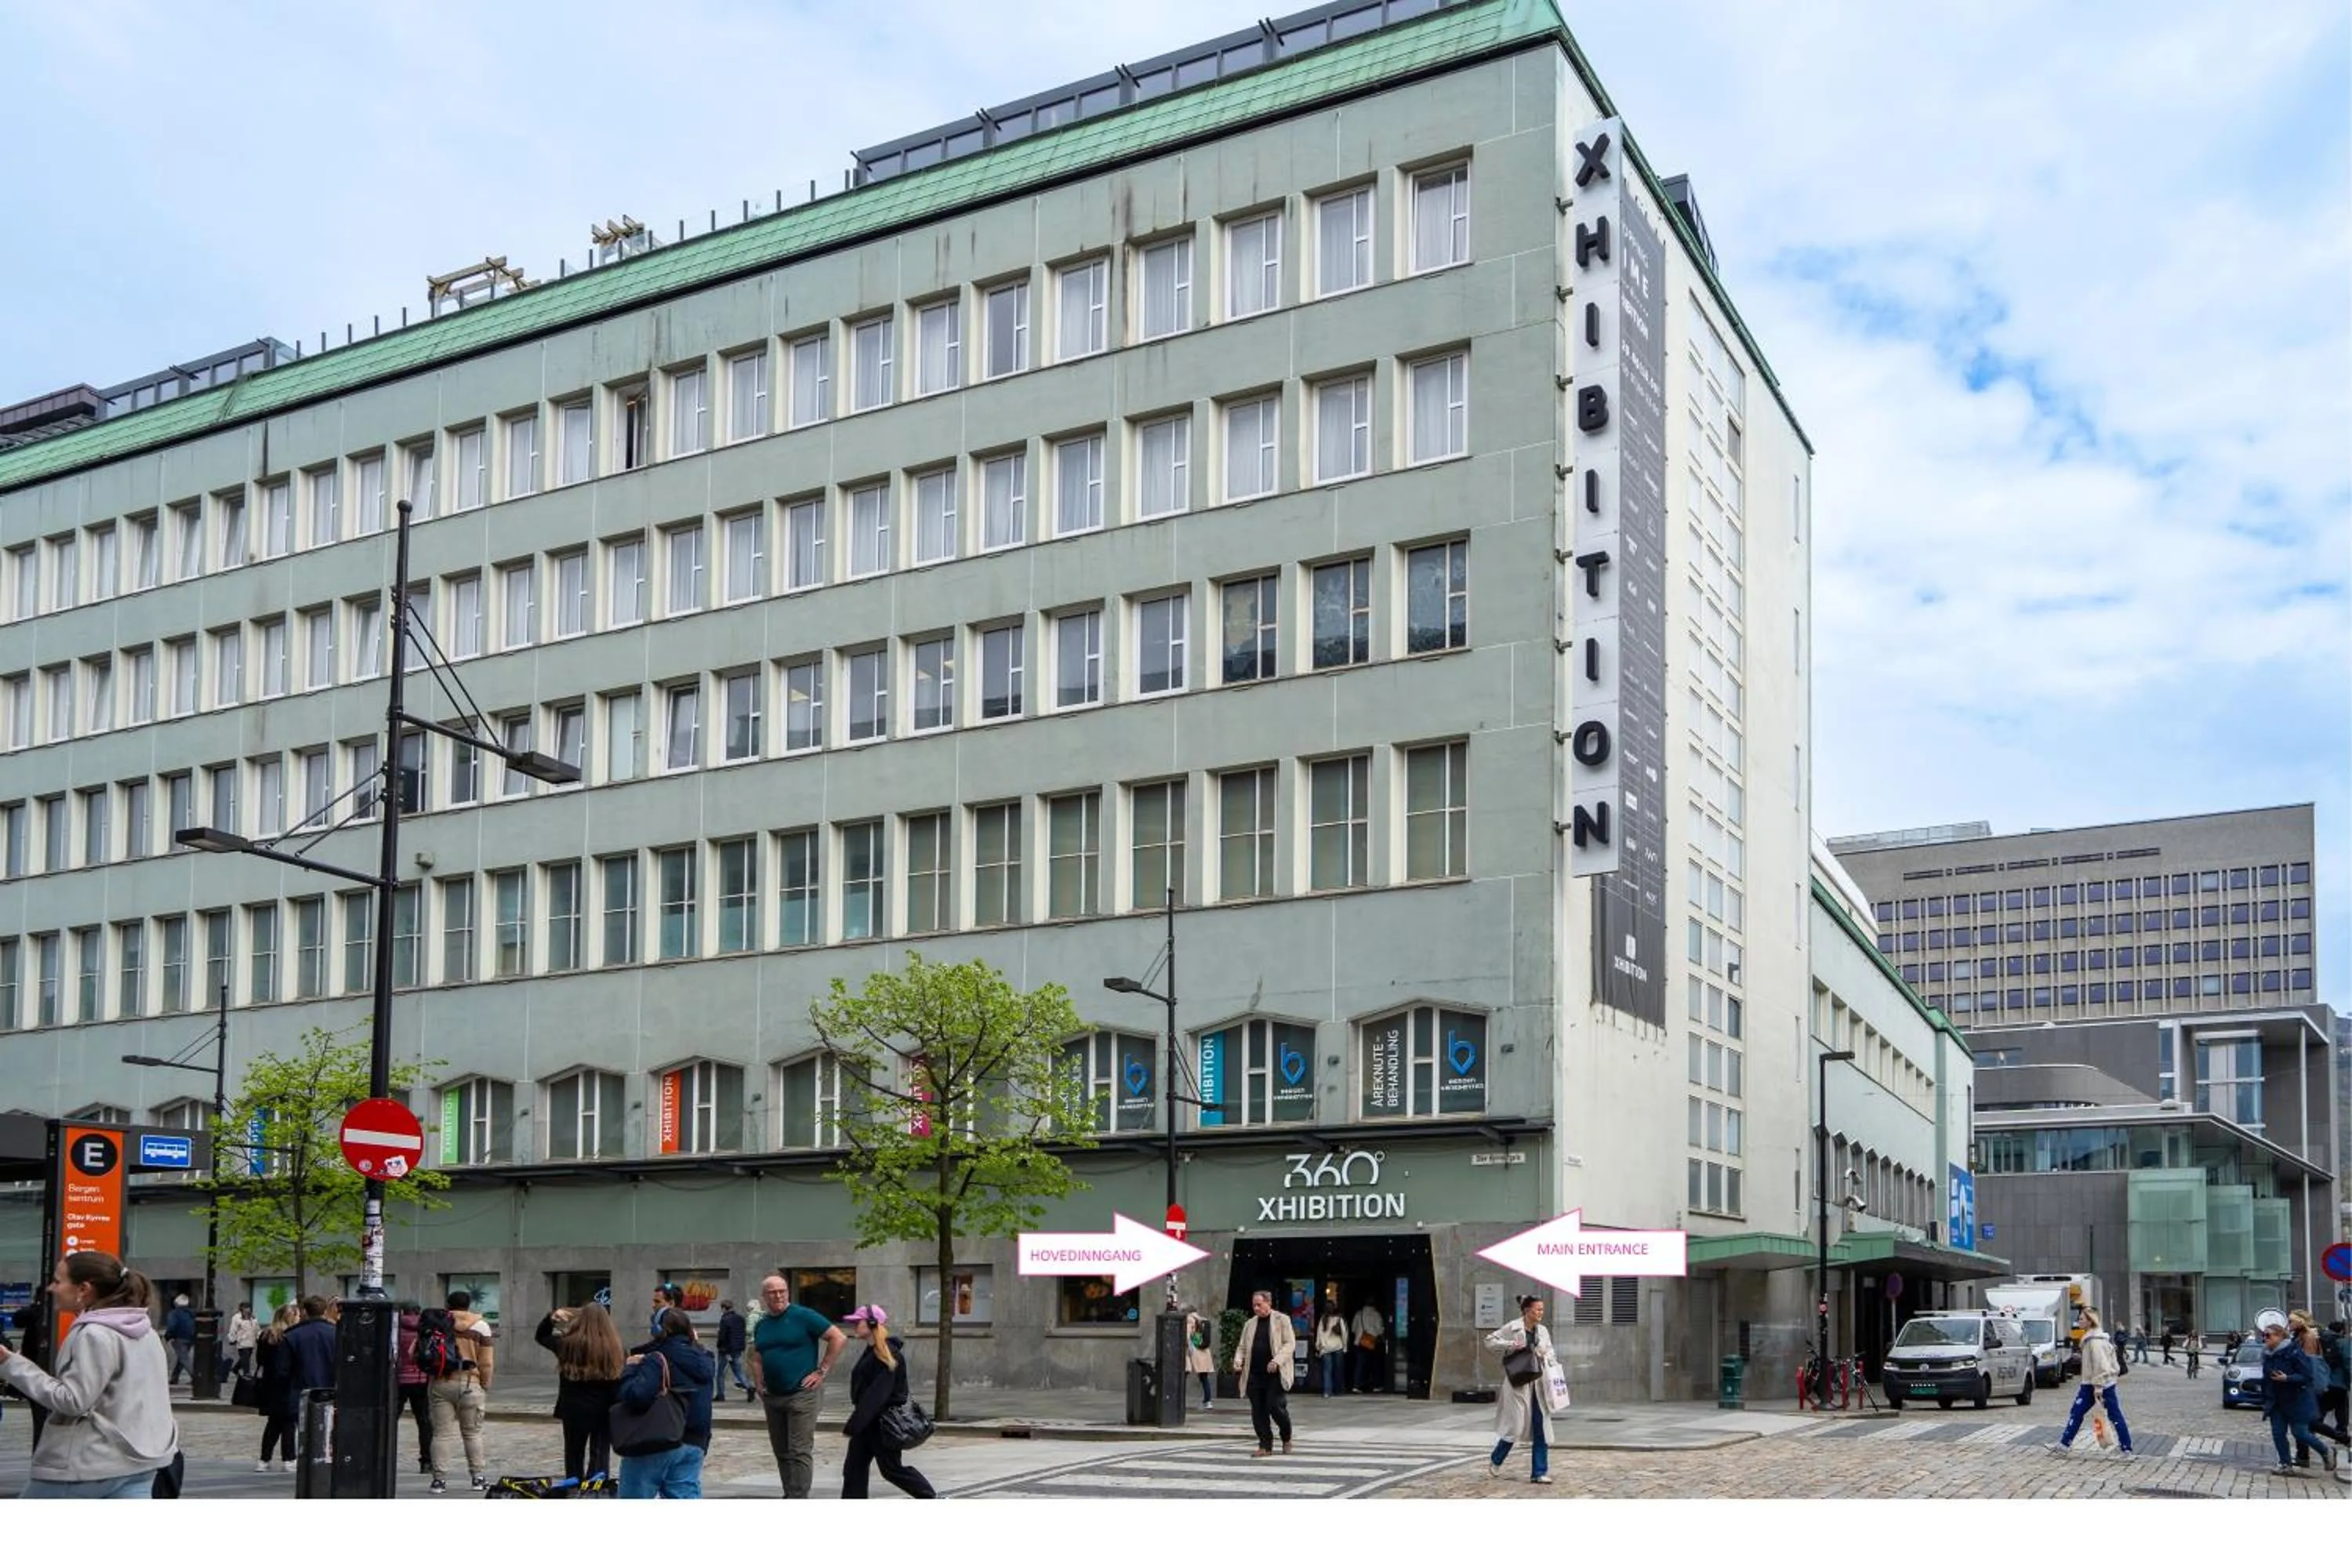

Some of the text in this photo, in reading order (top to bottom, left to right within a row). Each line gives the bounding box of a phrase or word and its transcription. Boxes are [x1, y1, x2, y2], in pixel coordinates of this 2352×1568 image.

[1573, 132, 1611, 848] XHIBITION
[1202, 1038, 1214, 1113] HIBITION
[1370, 1035, 1384, 1107] ÅREKNUTE-
[1387, 1029, 1399, 1107] BEHANDLING
[663, 1076, 673, 1142] XHIBITION
[83, 1142, 105, 1167] E
[67, 1183, 100, 1193] Bergen
[67, 1194, 105, 1203] sentrum
[1257, 1192, 1406, 1221] XHIBITION
